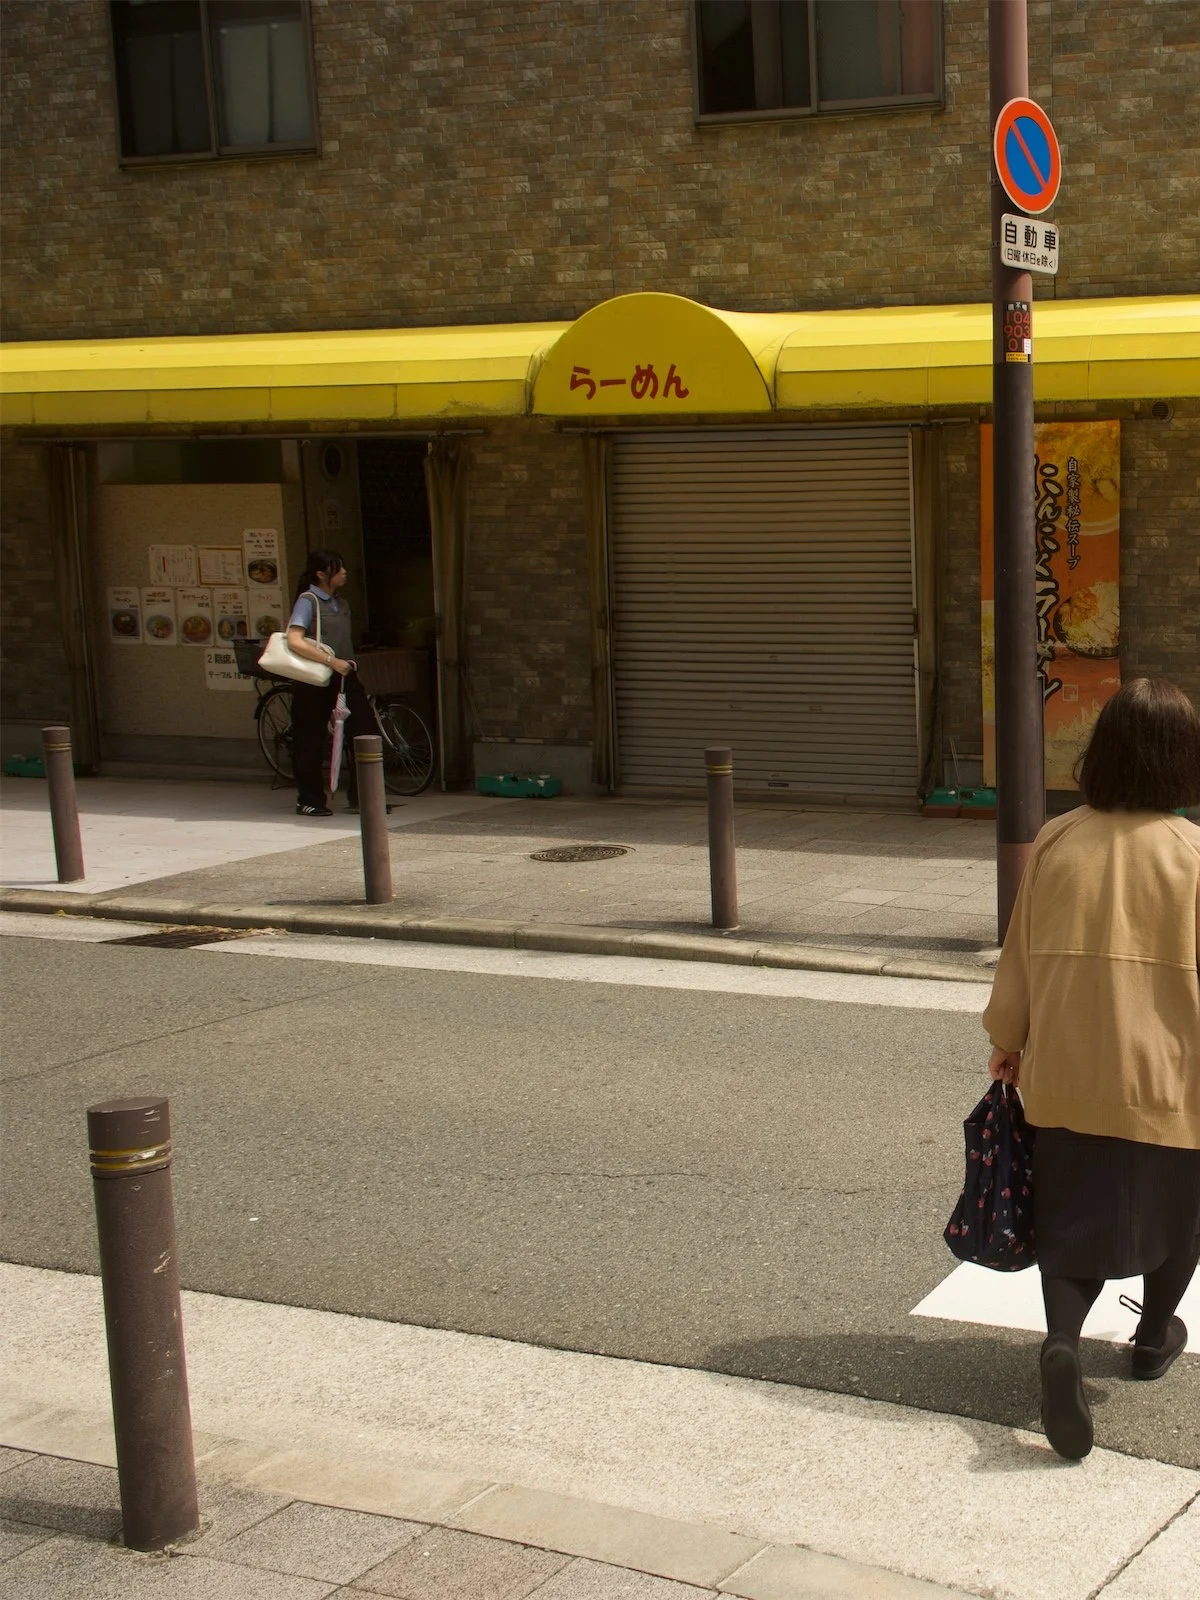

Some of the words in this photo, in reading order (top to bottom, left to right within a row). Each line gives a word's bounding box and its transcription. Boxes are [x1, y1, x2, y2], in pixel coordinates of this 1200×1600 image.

[1004, 220, 1057, 252] 自動車
[568, 363, 689, 400] らーめん
[1065, 457, 1082, 570] 自家製秘伝スープ
